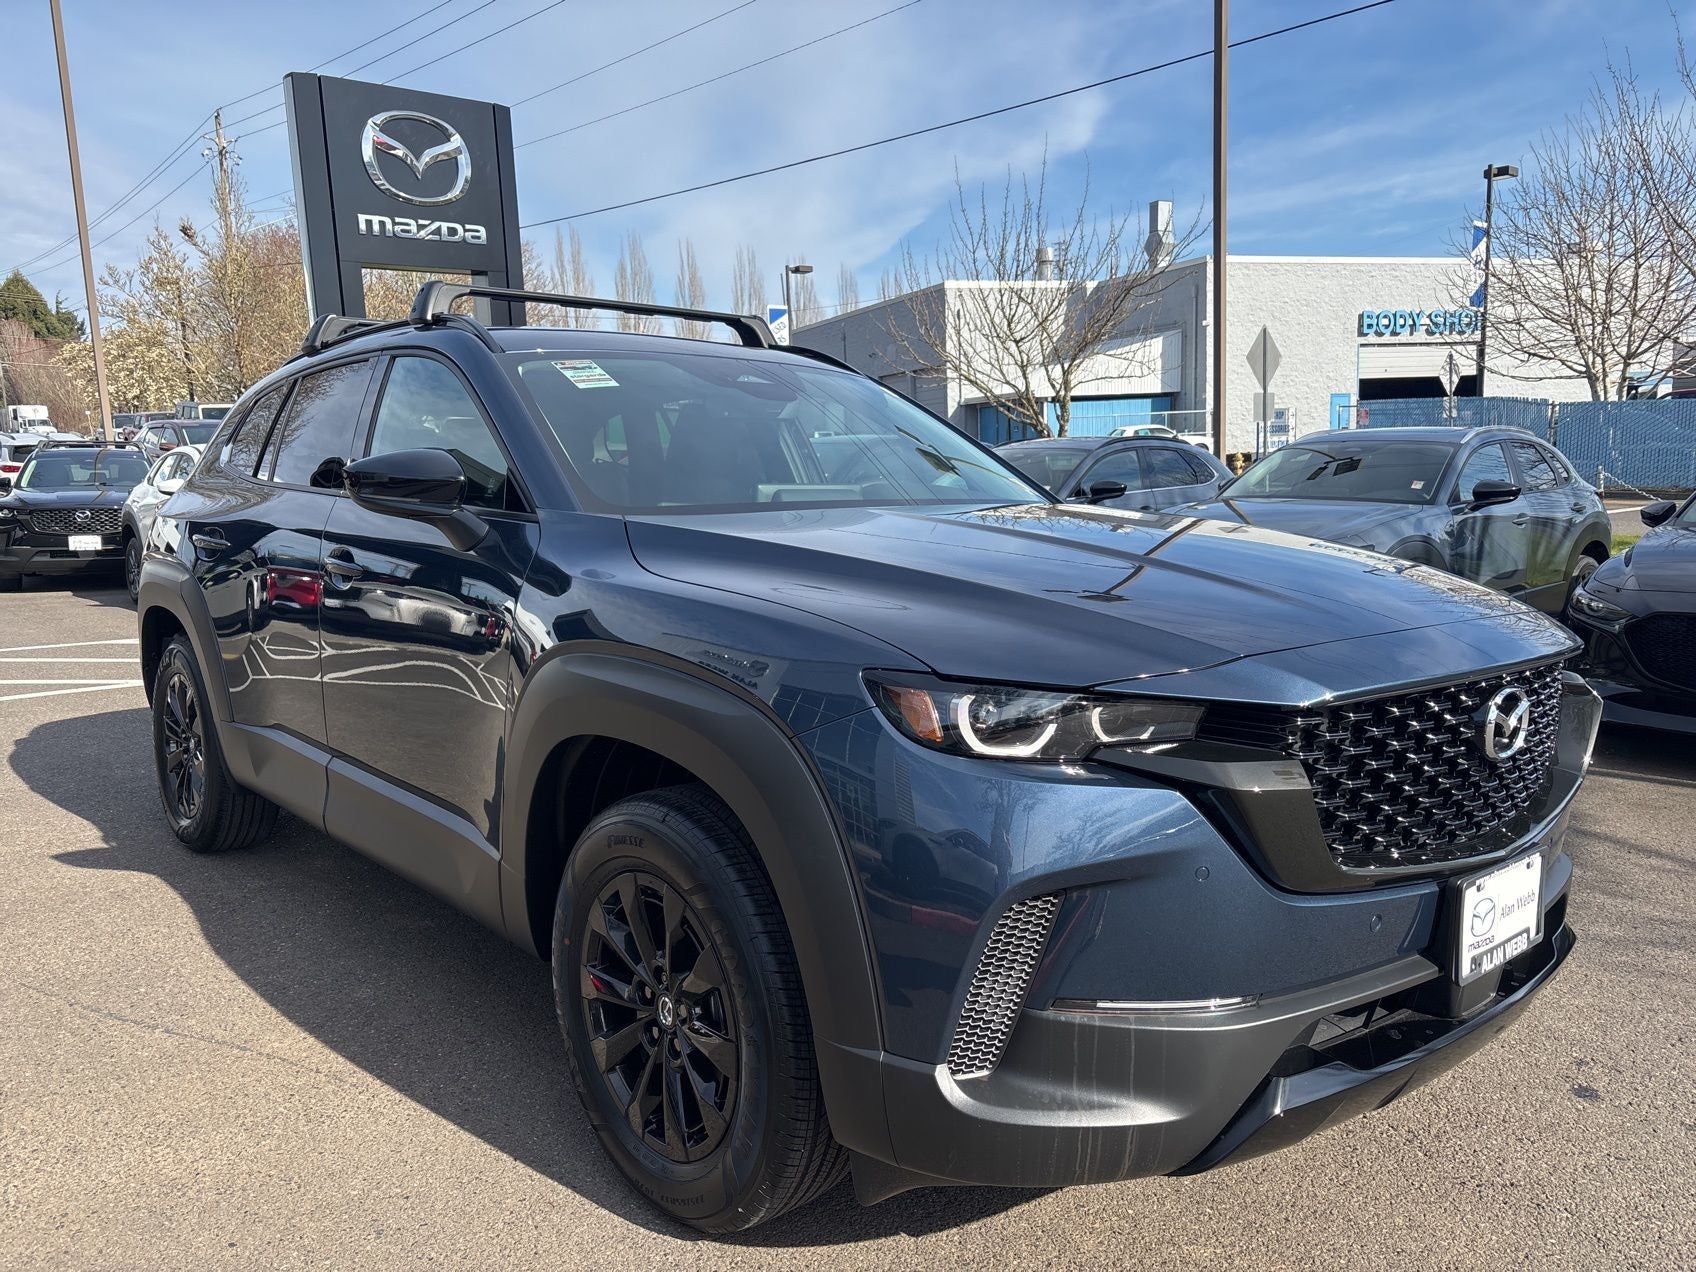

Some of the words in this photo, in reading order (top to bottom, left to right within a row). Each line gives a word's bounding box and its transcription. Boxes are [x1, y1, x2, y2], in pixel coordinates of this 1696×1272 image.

[1362, 309, 1423, 333] BODY
[1500, 903, 1516, 921] Alan
[1516, 889, 1536, 911] Webb
[1467, 934, 1495, 954] mazda
[1481, 946, 1505, 974] ALAN
[1504, 931, 1529, 961] WEBB
